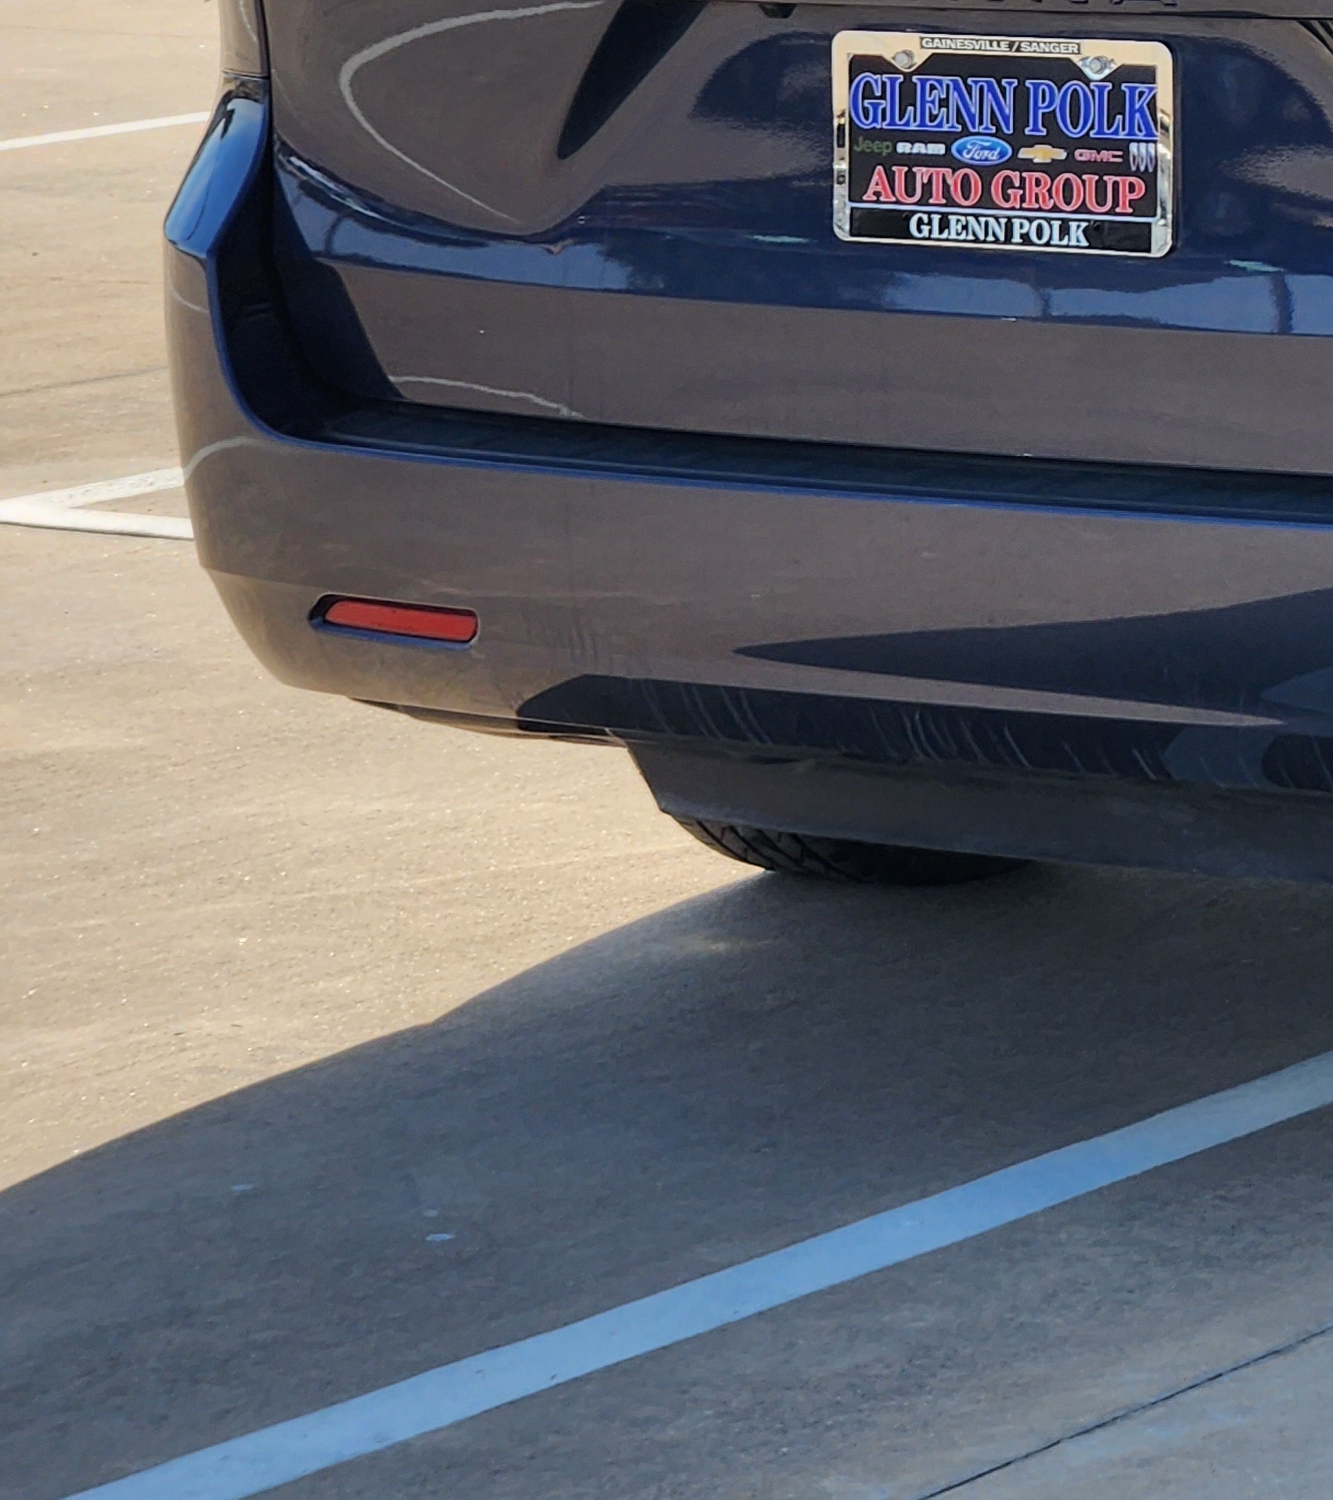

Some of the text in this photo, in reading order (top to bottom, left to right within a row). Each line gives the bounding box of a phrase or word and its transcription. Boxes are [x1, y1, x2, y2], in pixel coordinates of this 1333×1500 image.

[921, 36, 1011, 53] GAINESVILLE
[1019, 41, 1080, 55] SANGER
[849, 72, 1159, 141] GLENN POLK
[854, 136, 1124, 162] Jeep RAM Ford GMC
[861, 165, 1147, 214] AUTO GROUP
[908, 212, 1091, 247] GLENN POLK
